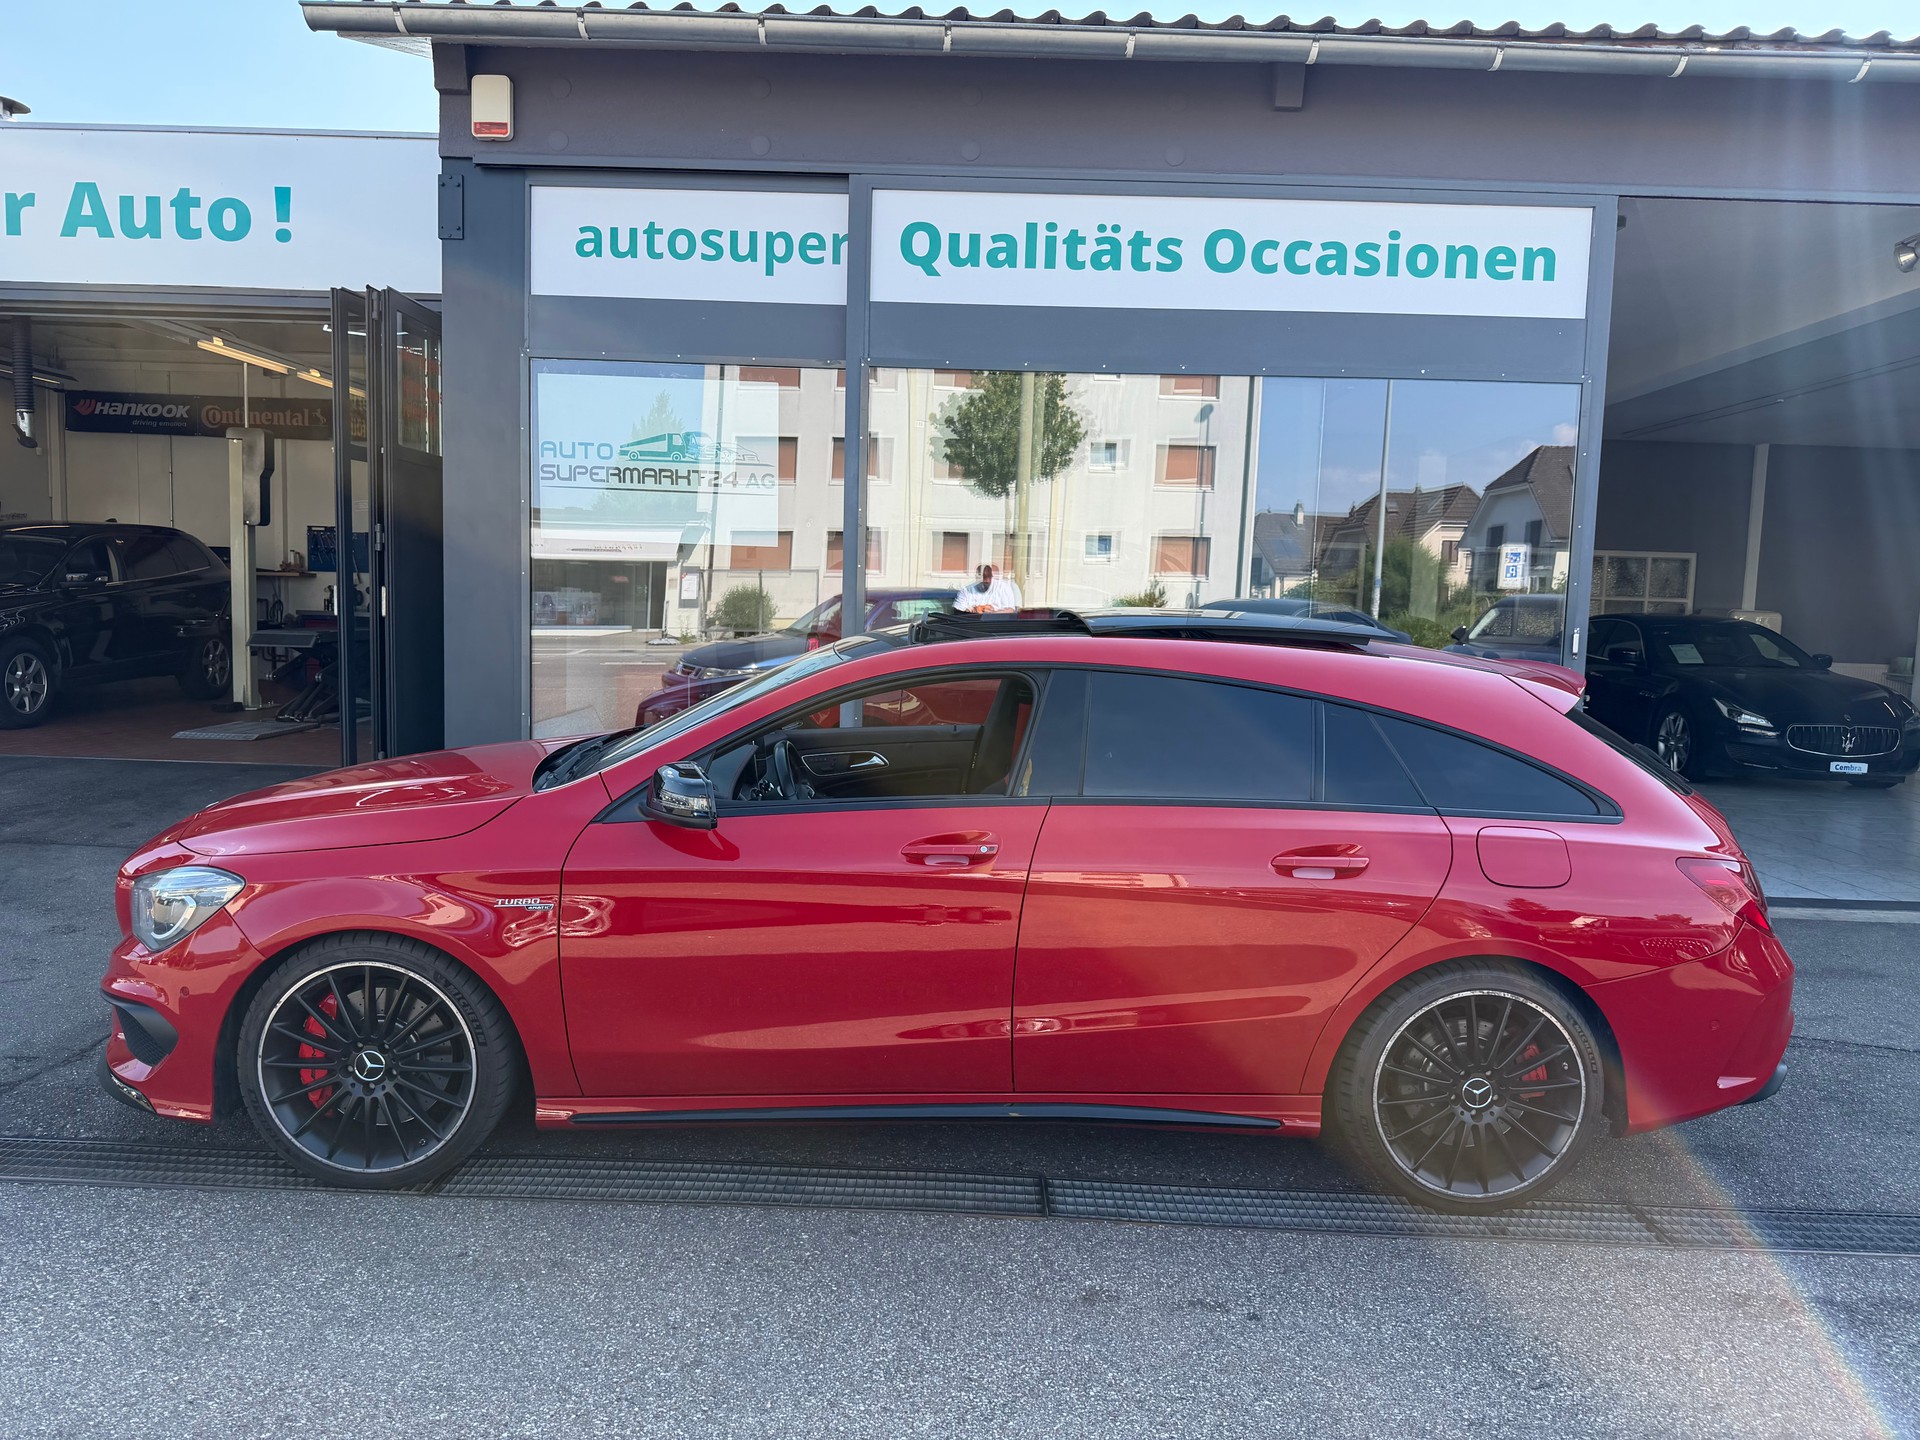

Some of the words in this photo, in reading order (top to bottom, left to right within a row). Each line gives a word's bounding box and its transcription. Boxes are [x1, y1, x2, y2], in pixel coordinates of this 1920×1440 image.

[60, 181, 252, 243] Auto
[574, 220, 849, 277] autosuper
[899, 221, 1184, 277] Qualitäts
[1203, 228, 1557, 282] Occasionen
[132, 419, 157, 427] driving
[540, 440, 614, 461] AUTO
[540, 463, 739, 489] SUPERMARKT24
[745, 472, 776, 490] AG
[1834, 763, 1863, 772] Cembra
[495, 897, 541, 906] TURBO
[445, 983, 487, 1043] MICHELIN
